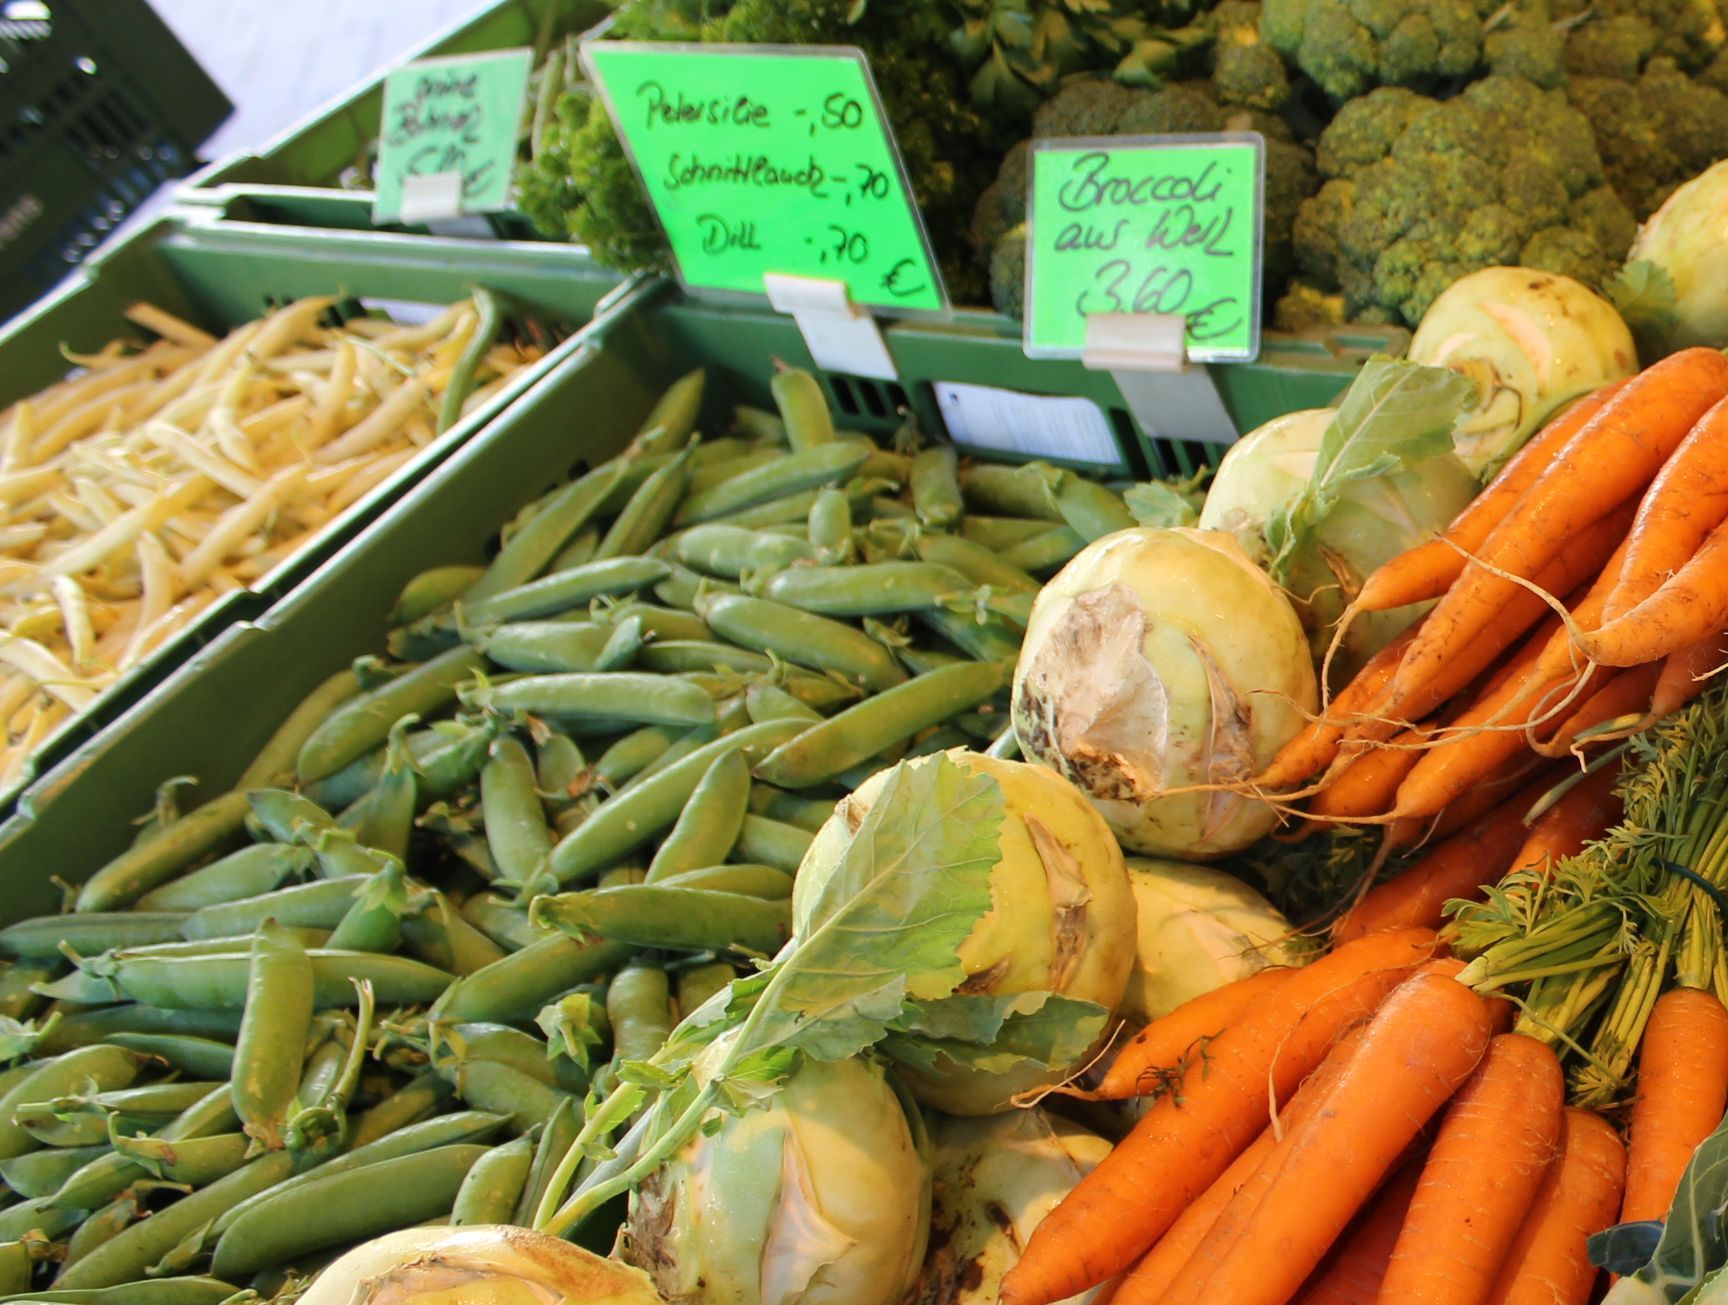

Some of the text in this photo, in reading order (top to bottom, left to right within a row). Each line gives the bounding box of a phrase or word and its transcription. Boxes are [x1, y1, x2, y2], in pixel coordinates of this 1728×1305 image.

[636, 80, 771, 131] Petersilie
[663, 153, 829, 200] Schnittlauch
[1059, 152, 1232, 212] Broccoli
[697, 213, 762, 256] Dill
[1054, 219, 1130, 252] aus
[881, 257, 926, 298] €
